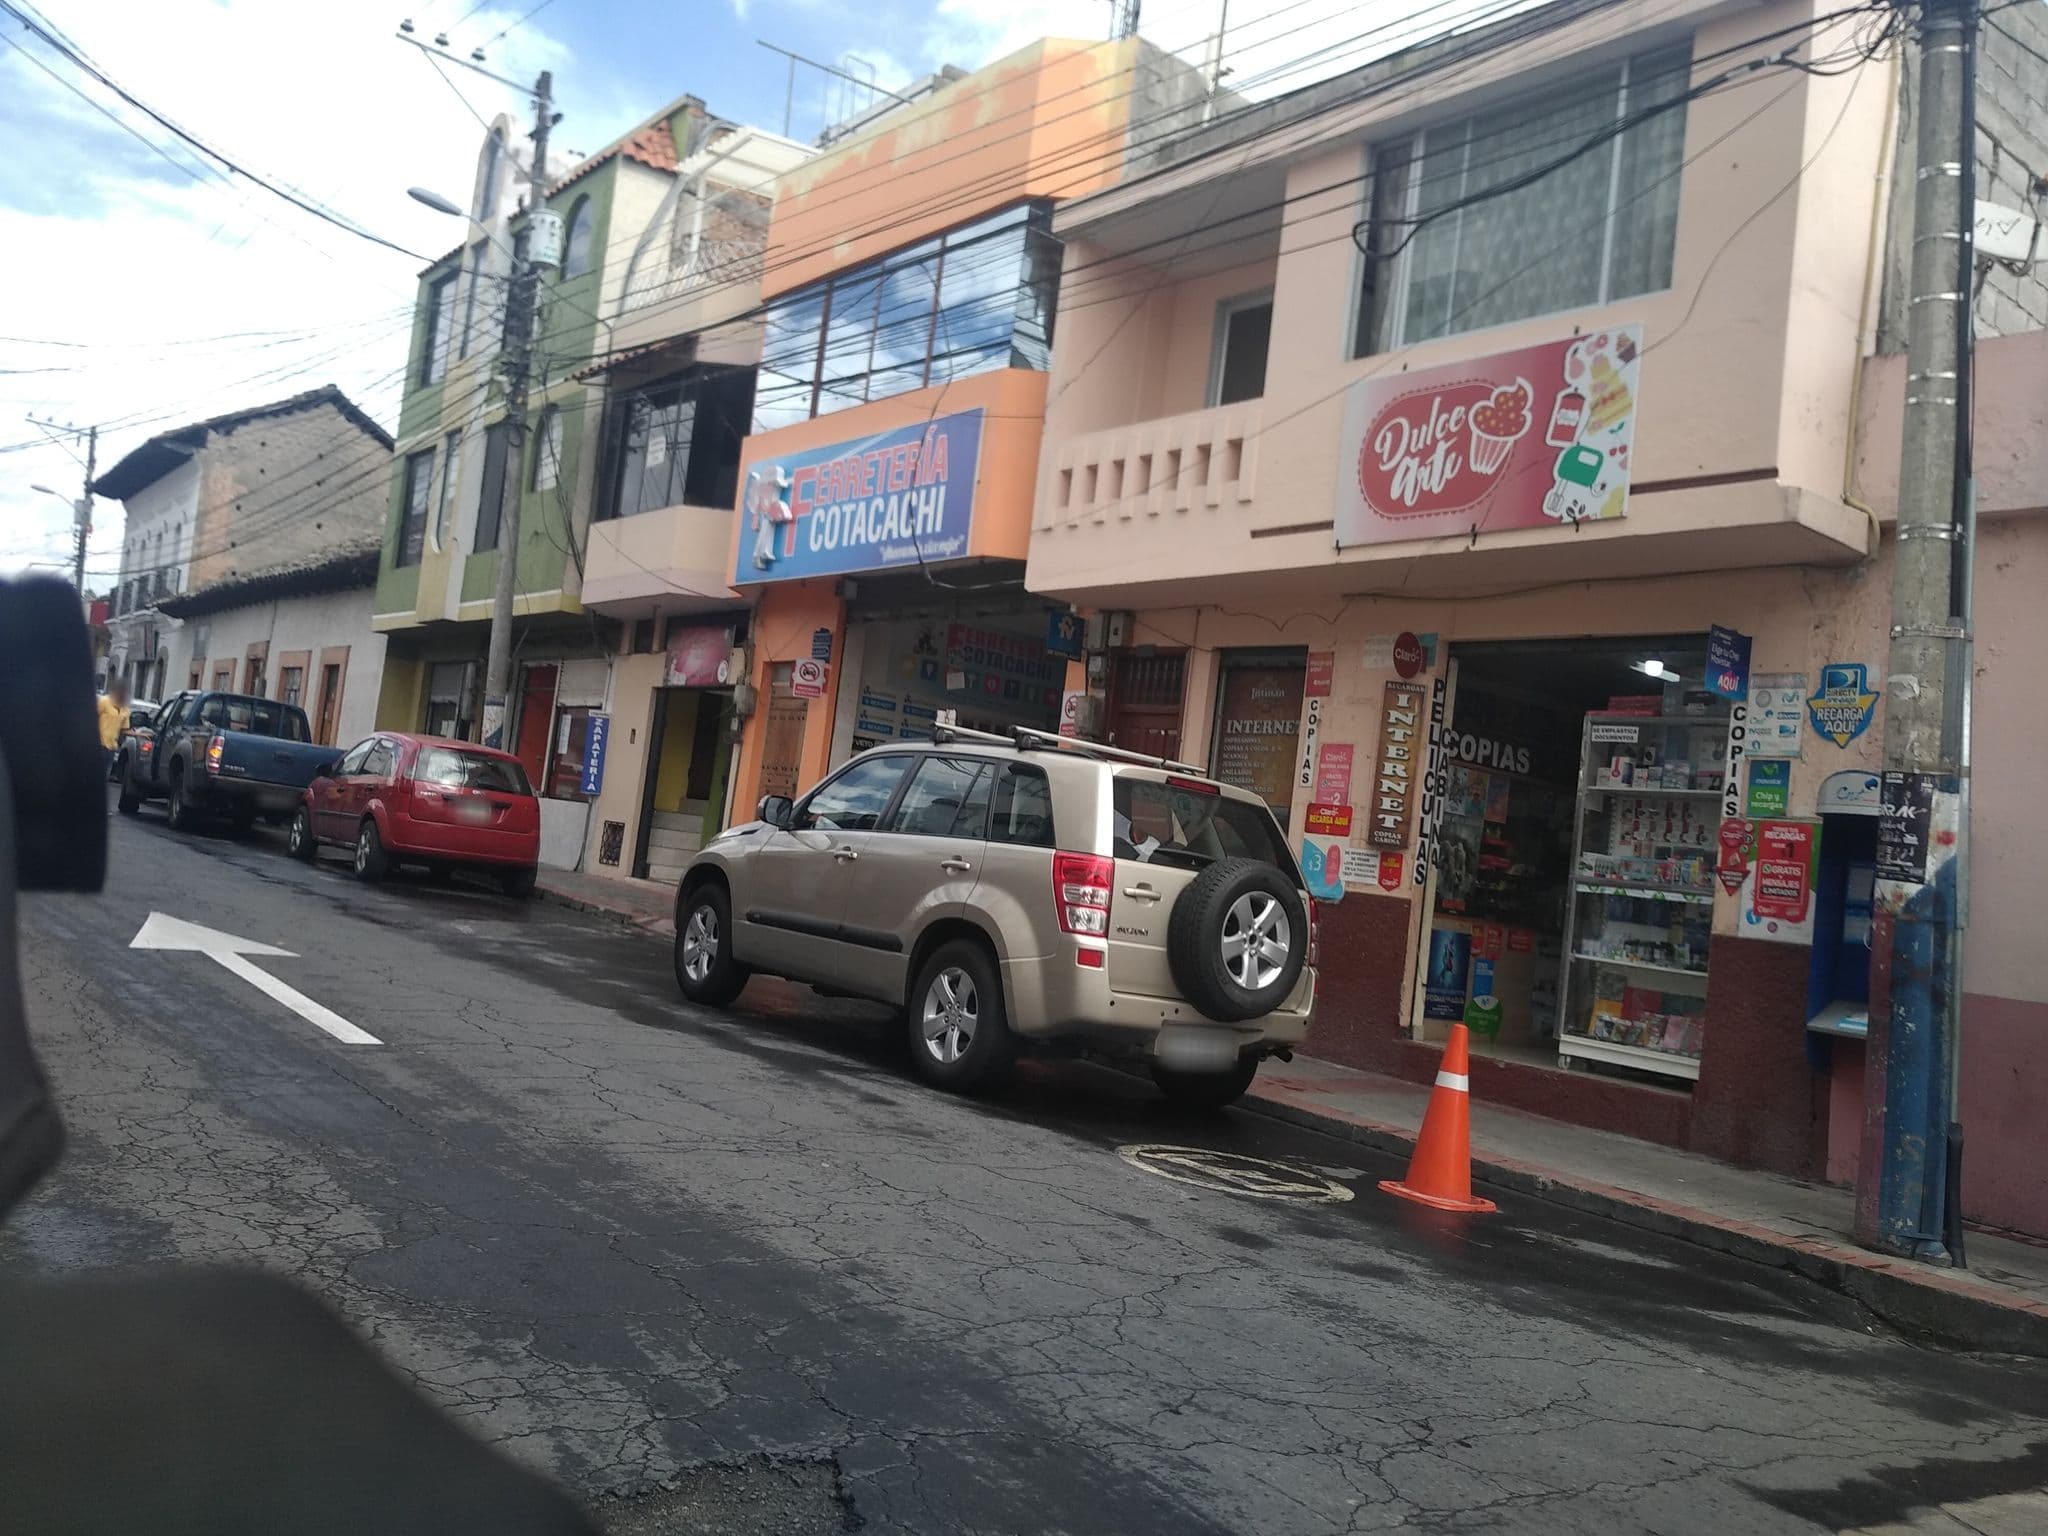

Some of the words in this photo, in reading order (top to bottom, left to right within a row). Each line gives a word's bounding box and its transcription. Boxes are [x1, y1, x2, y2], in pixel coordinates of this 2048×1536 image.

[1375, 396, 1465, 471] Dulce
[784, 424, 949, 557] FERRETERÍA
[810, 484, 947, 552] COTACACHI
[1395, 647, 1420, 662] Claro
[1301, 700, 1319, 784] COPIAS
[1817, 708, 1864, 721] RECARGA
[587, 718, 603, 791] ZAPATERIA
[1377, 693, 1416, 830] INTERNET
[1414, 678, 1445, 885] PELICULAS
[1446, 729, 1531, 774] COPIAS
[1725, 706, 1747, 815] COPIAS
[1755, 791, 1773, 801] Chip
[1772, 864, 1802, 876] GRATIS
